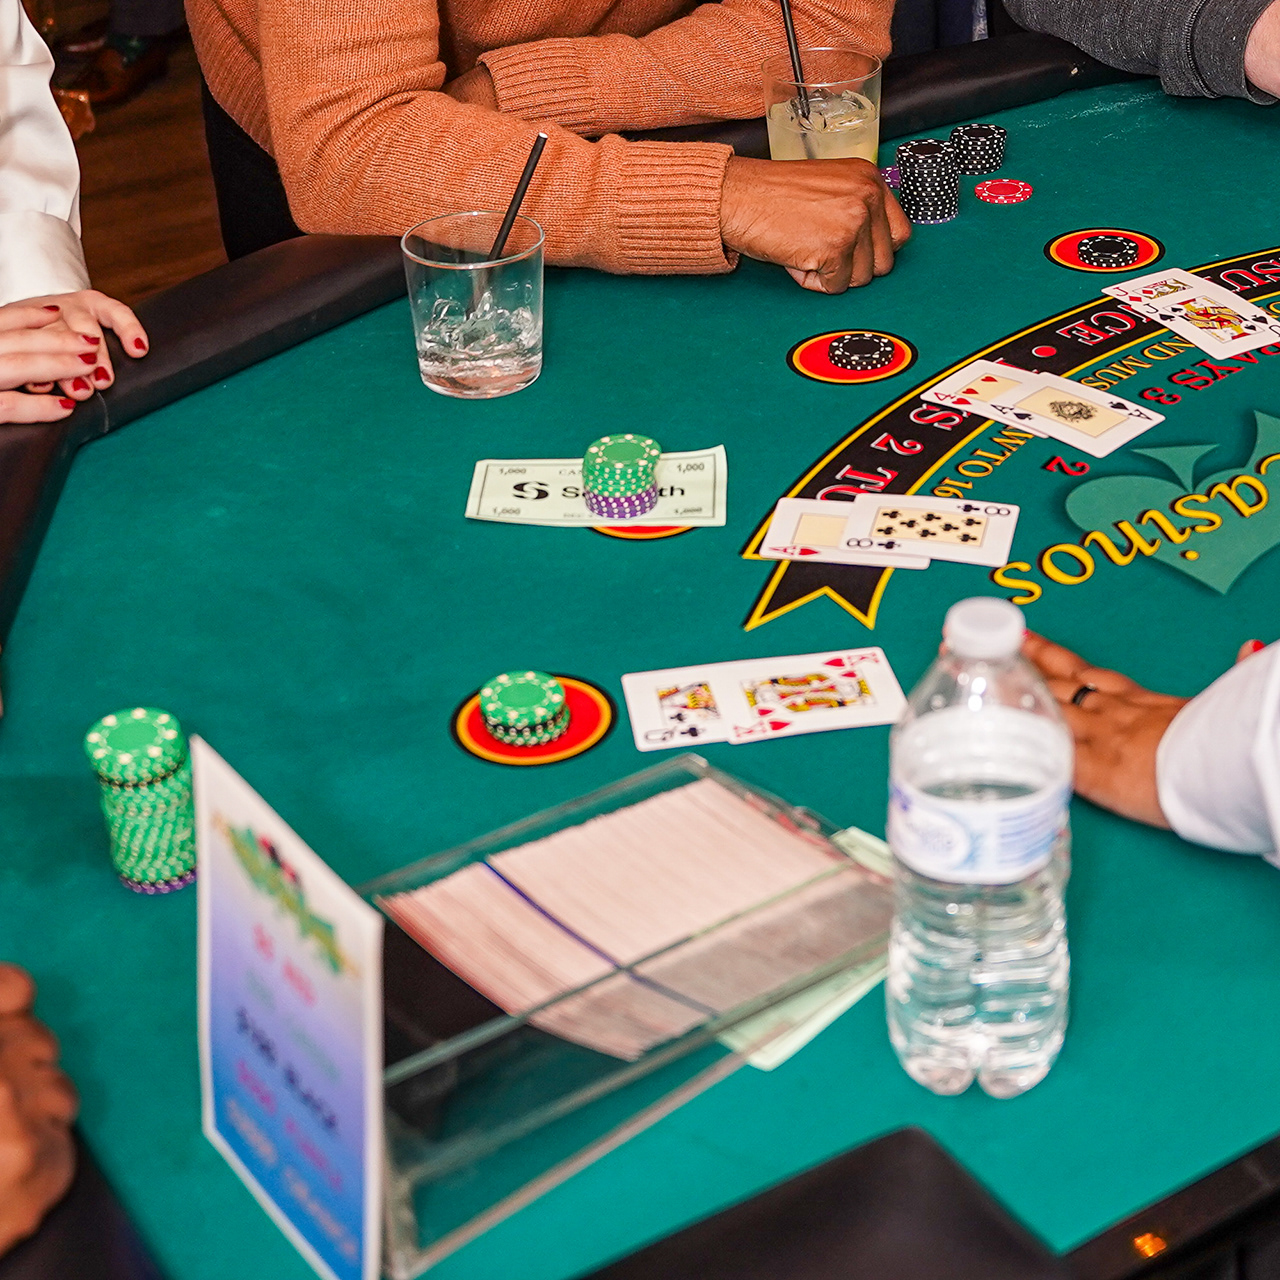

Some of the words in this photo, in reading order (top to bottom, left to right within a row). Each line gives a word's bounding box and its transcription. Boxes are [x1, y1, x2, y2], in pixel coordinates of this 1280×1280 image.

[1079, 355, 1154, 391] MUS
[1141, 387, 1182, 405] 3
[871, 432, 924, 456] 2
[499, 467, 527, 475] 1,000
[677, 463, 705, 473] 1,000
[1043, 456, 1091, 476] 2
